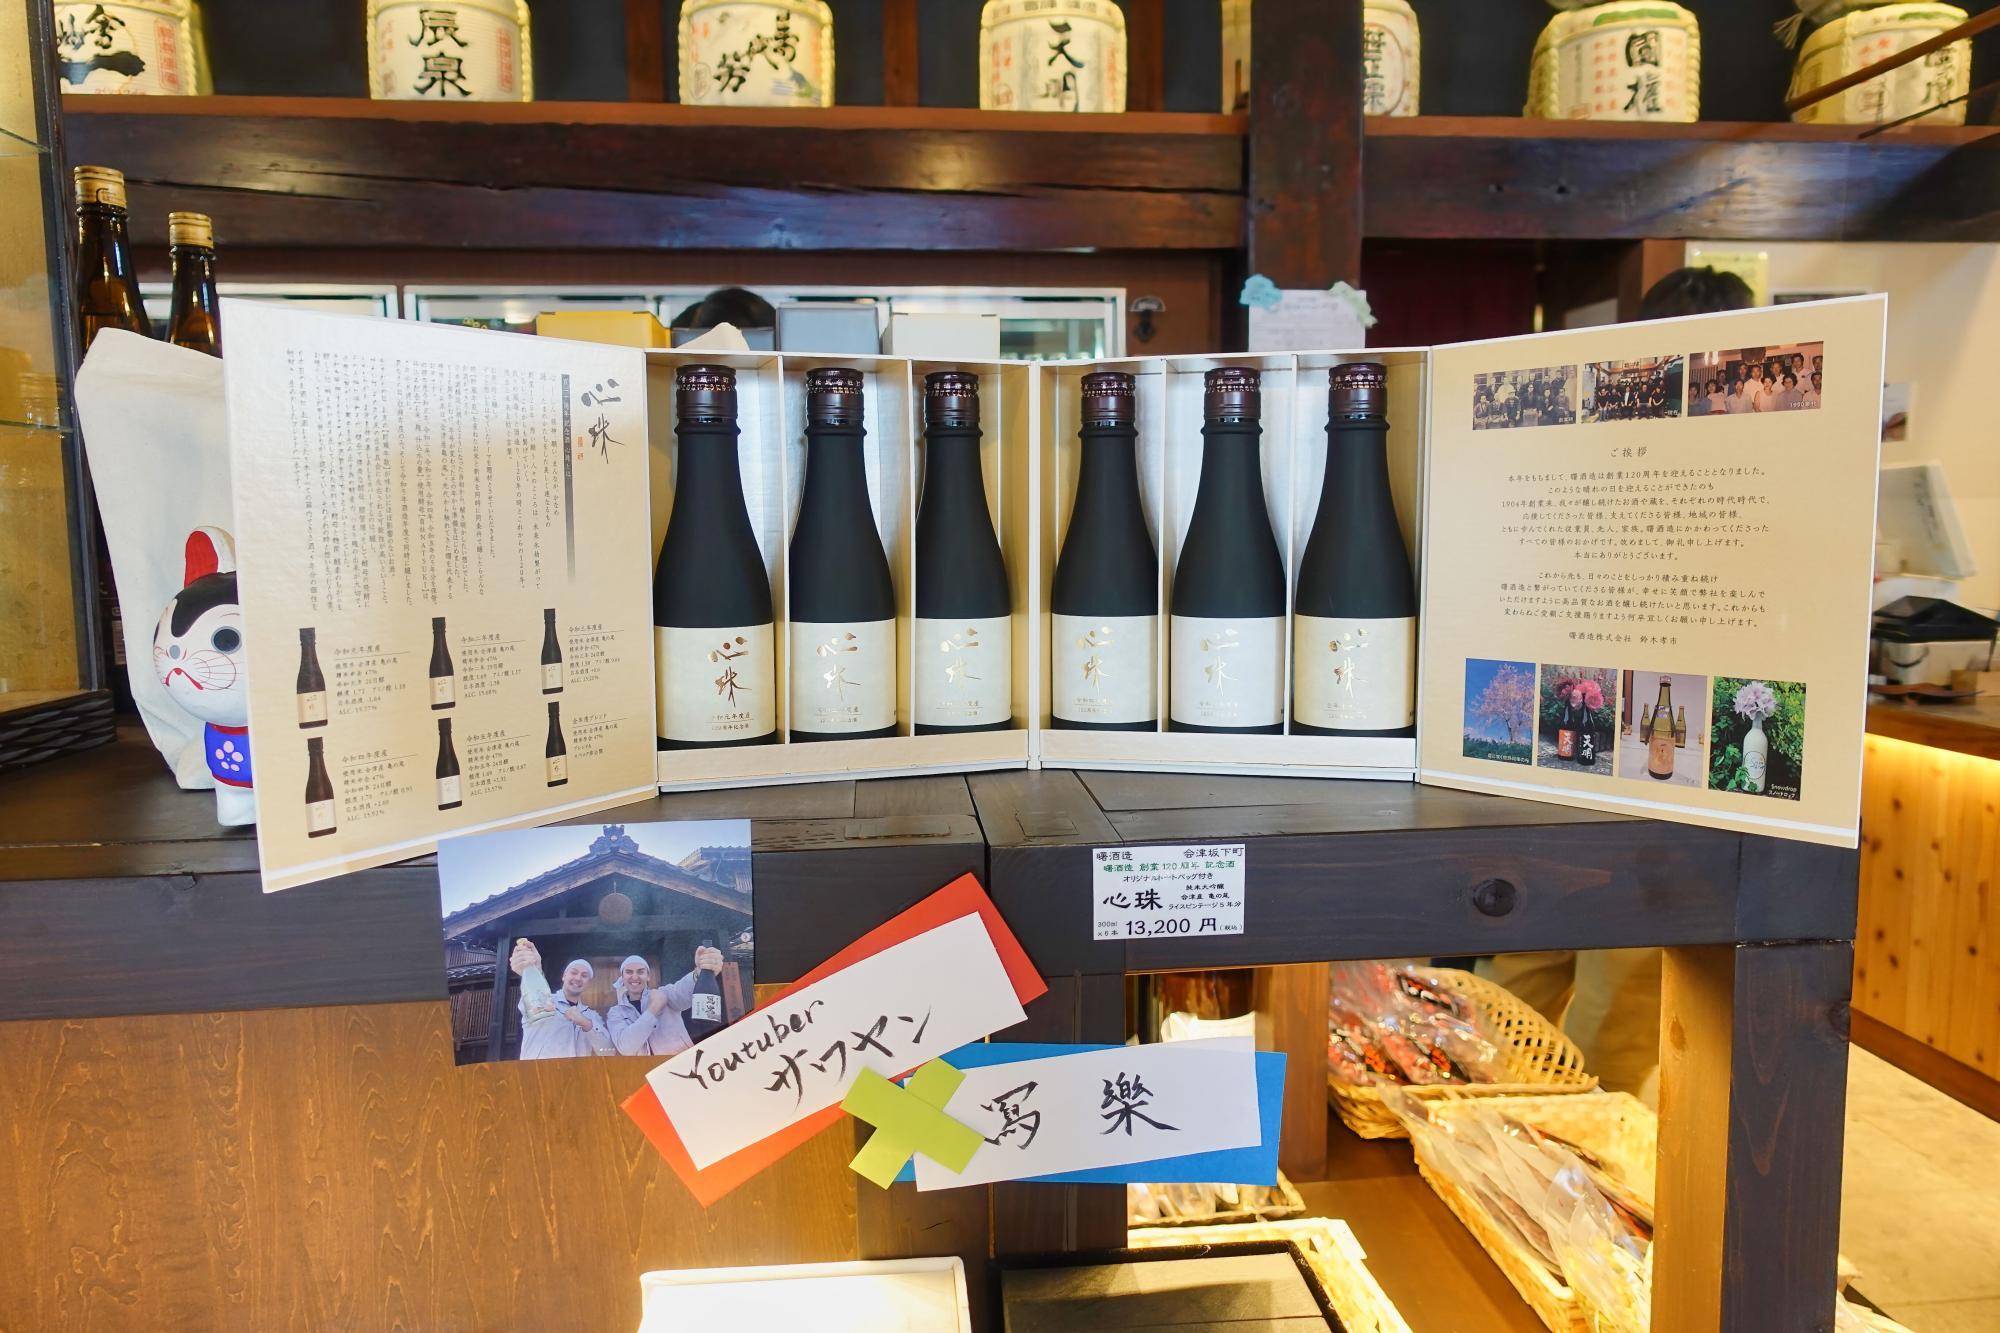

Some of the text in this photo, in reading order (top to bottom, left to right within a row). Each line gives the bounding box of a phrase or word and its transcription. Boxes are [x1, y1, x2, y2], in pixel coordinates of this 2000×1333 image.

[408, 9, 472, 97] 辰泉
[1039, 19, 1085, 112] 天明
[1610, 446, 1648, 458] ご挨拶
[1574, 551, 1679, 561] 本当にありがとうございます。
[1581, 734, 1594, 760] 天明
[1096, 847, 1244, 861] 曙酒造 会津坂下町
[1103, 863, 1134, 872] 曙酒造
[1205, 860, 1235, 869] 記念酒
[1123, 873, 1213, 883] オリジナルトートバッグ付き
[1103, 888, 1163, 911] 心珠
[1125, 918, 1190, 937] 13,200
[1199, 917, 1217, 932] 円
[669, 998, 825, 1091] Youtuber
[763, 1003, 932, 1109] ザワヤン
